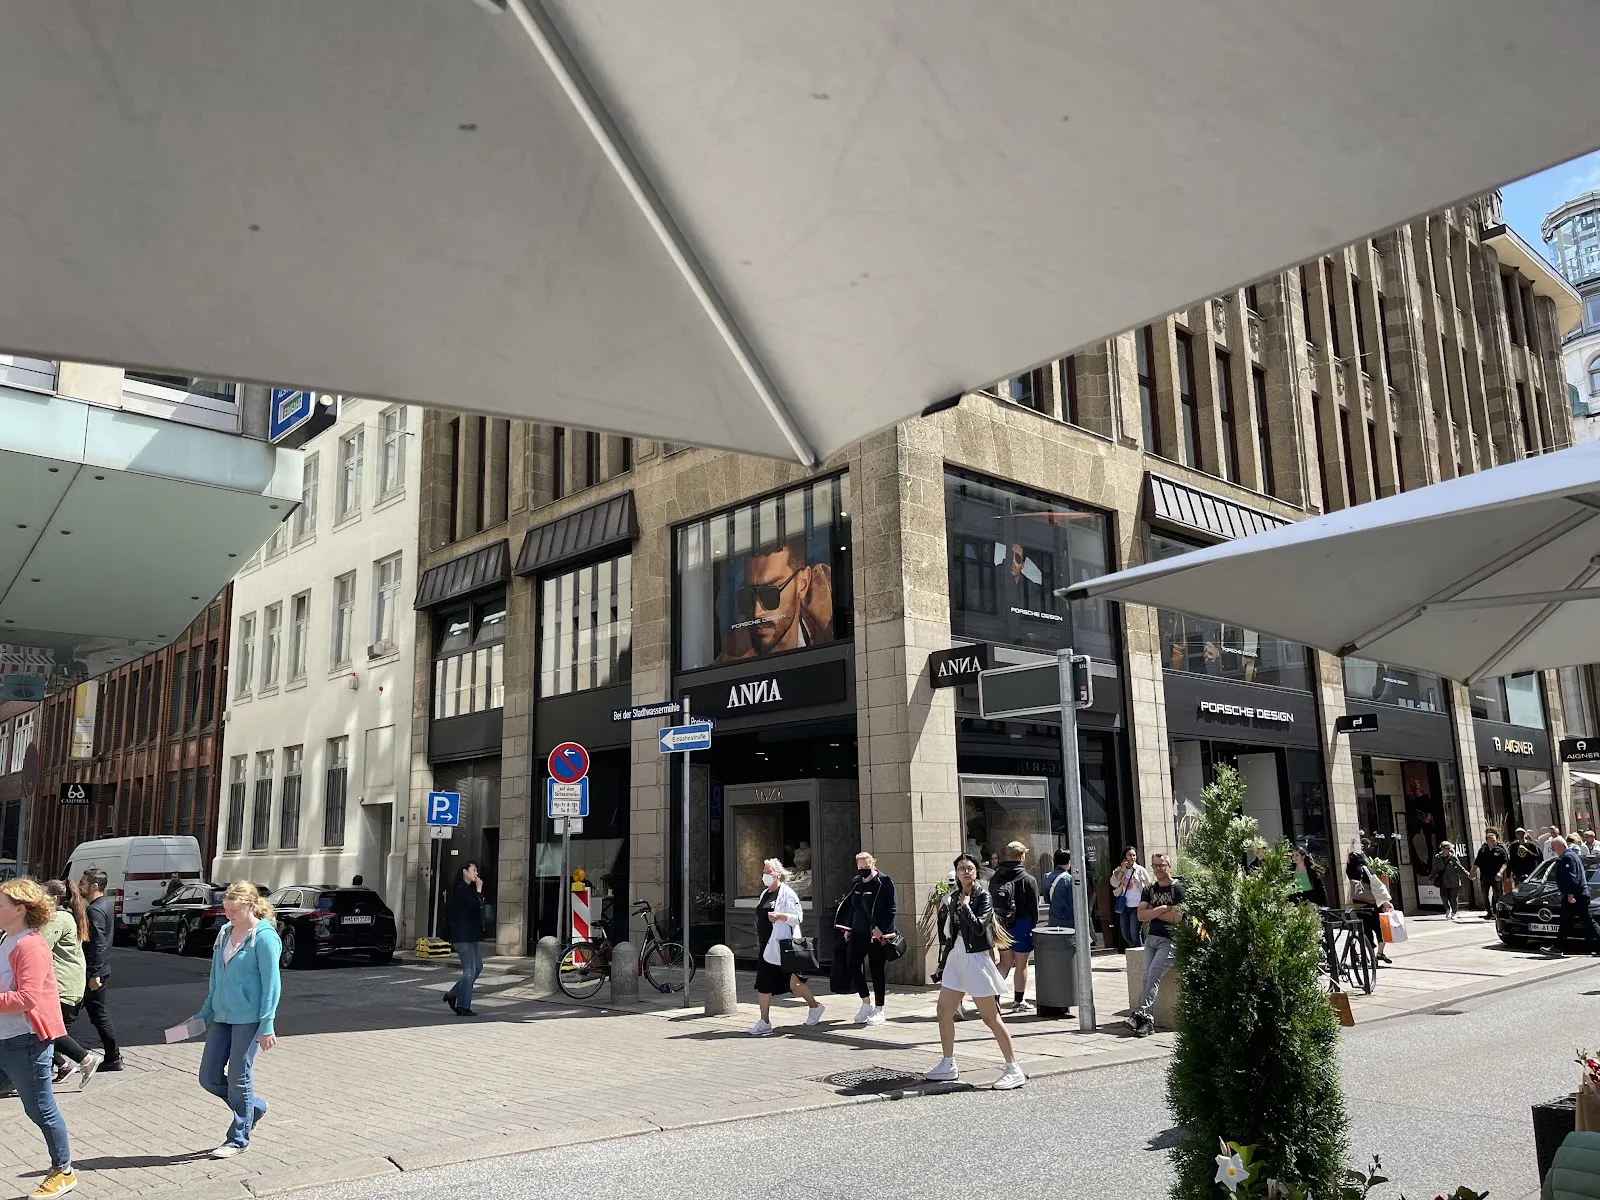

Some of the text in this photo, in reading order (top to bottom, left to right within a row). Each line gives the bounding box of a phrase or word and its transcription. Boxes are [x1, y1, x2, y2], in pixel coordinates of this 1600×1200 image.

[731, 613, 786, 629] PORSCHE DESIGN
[1010, 606, 1063, 622] PORSCHE DESIGN
[613, 702, 680, 720] Bei der Stadtwassermühle
[1200, 701, 1294, 723] PORSCHE DESIGN
[672, 733, 706, 743] Einbahnstraße
[1504, 739, 1534, 755] AIGNER
[1566, 752, 1600, 760] AIGNER
[432, 796, 450, 821] P
